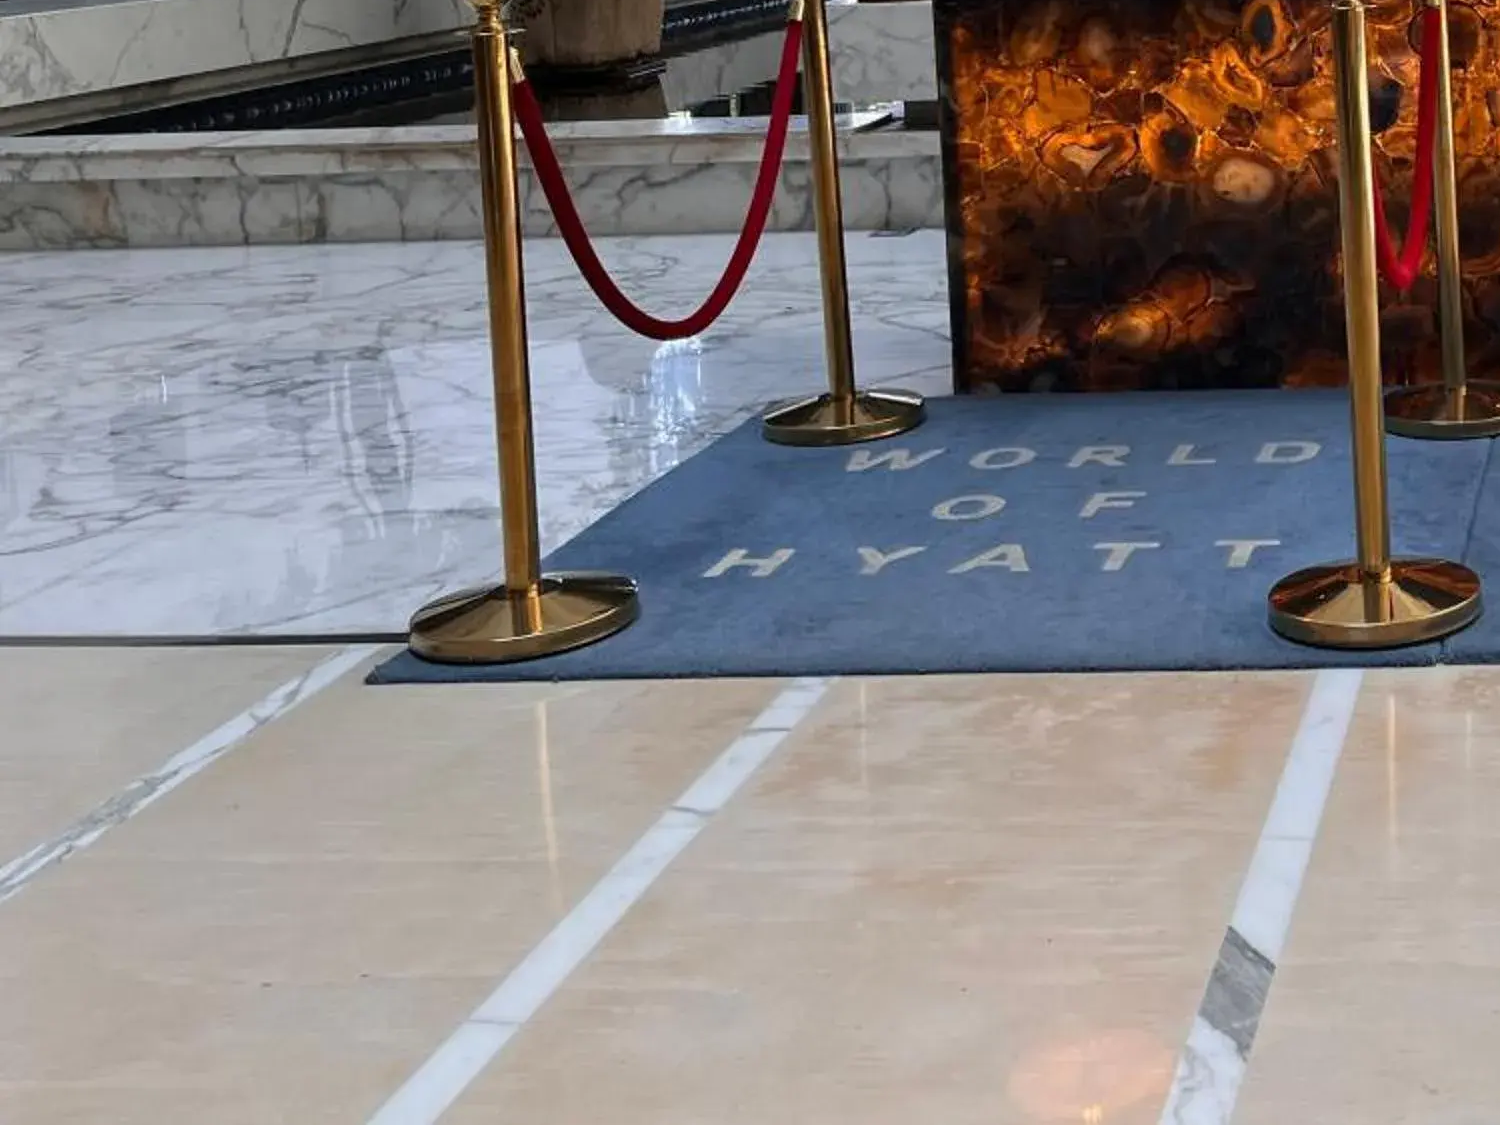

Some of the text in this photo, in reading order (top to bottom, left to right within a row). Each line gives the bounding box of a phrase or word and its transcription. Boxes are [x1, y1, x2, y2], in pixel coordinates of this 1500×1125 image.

[845, 441, 1322, 472] WORLD
[931, 491, 1146, 521] OF
[703, 540, 1281, 578] HYATT
